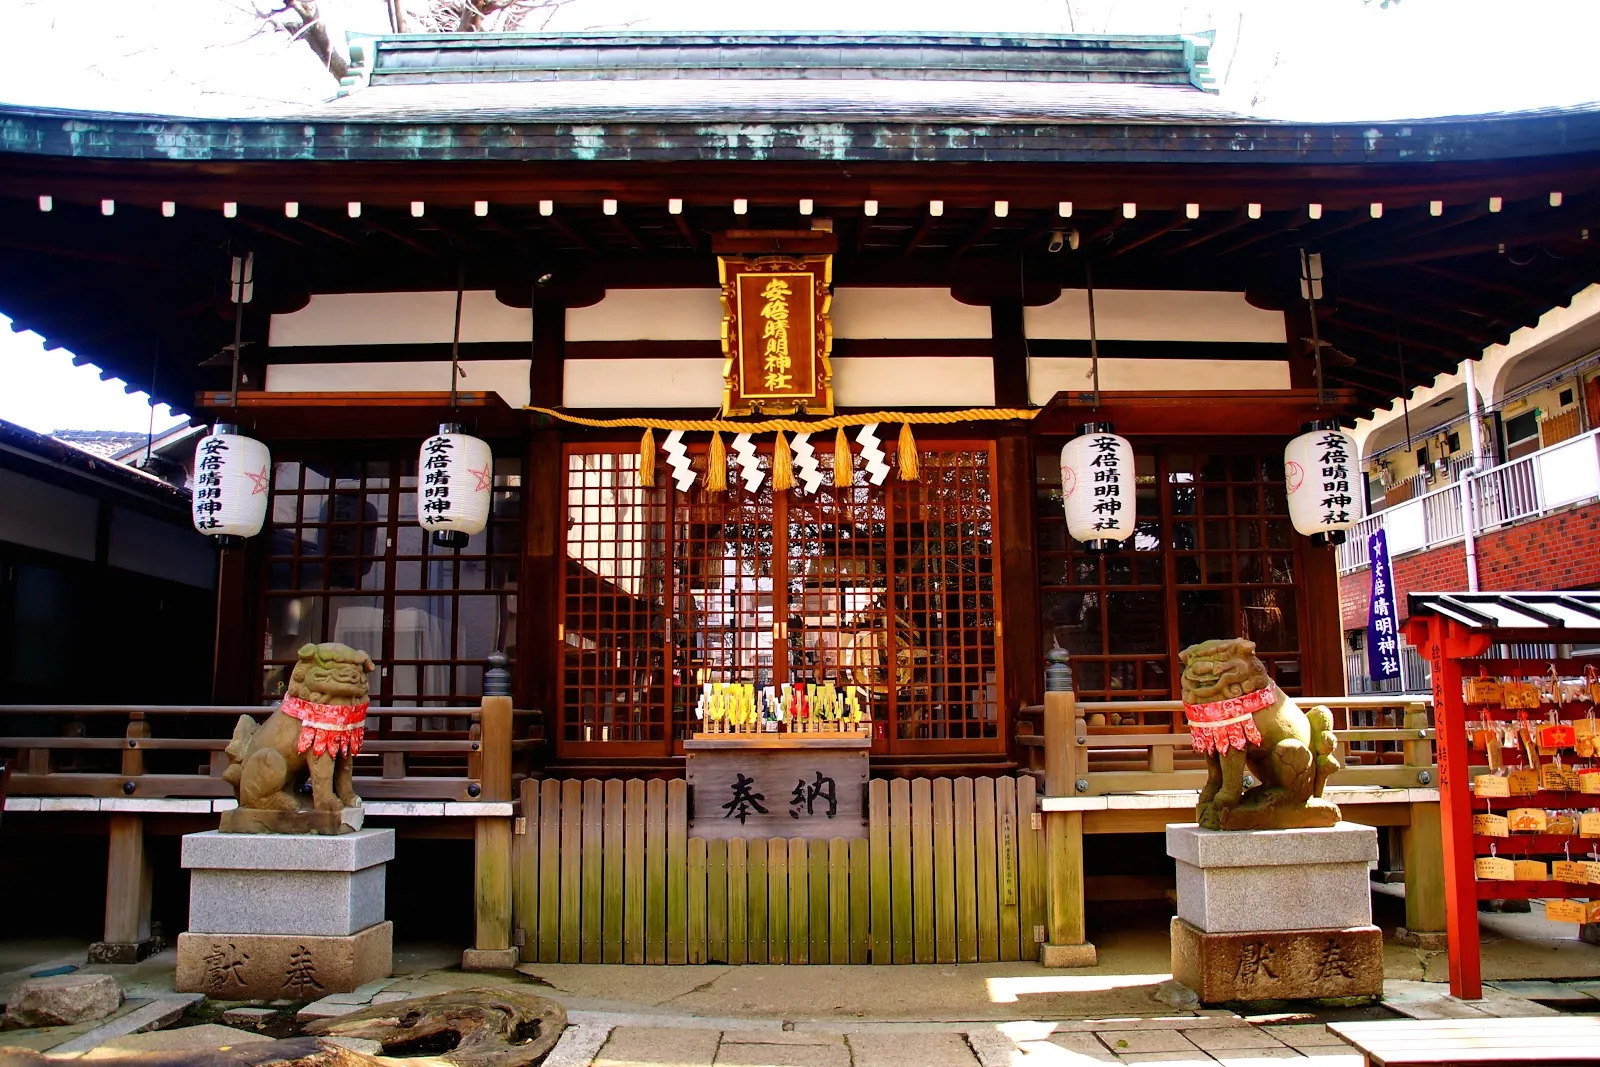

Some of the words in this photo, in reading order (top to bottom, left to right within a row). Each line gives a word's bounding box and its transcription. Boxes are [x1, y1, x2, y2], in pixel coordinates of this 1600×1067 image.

[760, 278, 793, 392] 安倍晴明神社
[196, 438, 229, 530] 安倍晴明神社
[423, 437, 454, 525] 安倍晴明神社
[1088, 436, 1122, 531] 安倍晴明神社
[1316, 432, 1352, 525] 安倍晴明神社
[1373, 559, 1399, 676] 安倍晴明神社
[721, 770, 838, 826] 奉納
